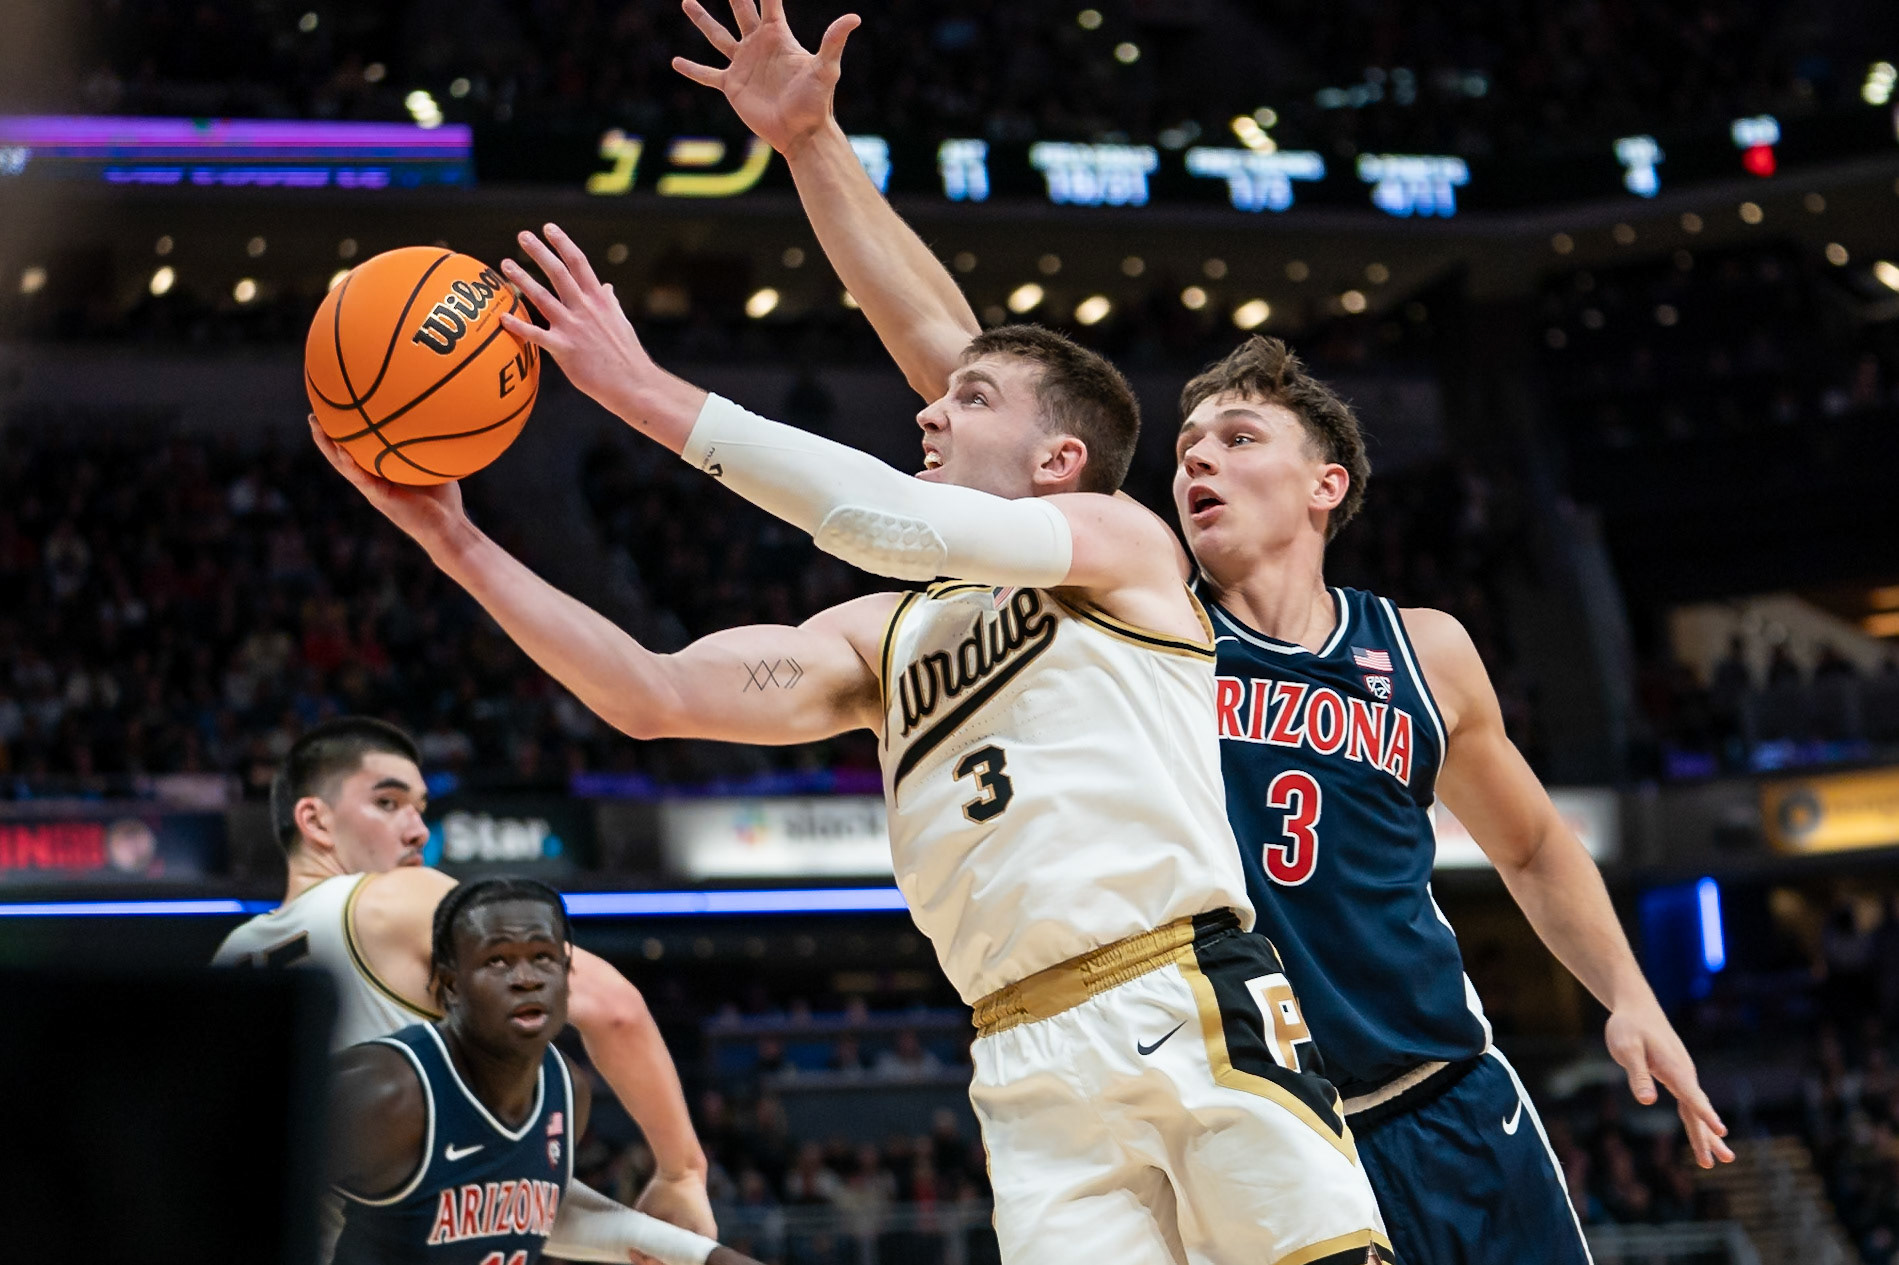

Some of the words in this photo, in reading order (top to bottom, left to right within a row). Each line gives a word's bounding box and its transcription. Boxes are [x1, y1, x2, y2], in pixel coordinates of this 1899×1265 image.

[952, 744, 1014, 825] 3
[1216, 675, 1413, 787] RIZONA
[1263, 770, 1322, 886] 3
